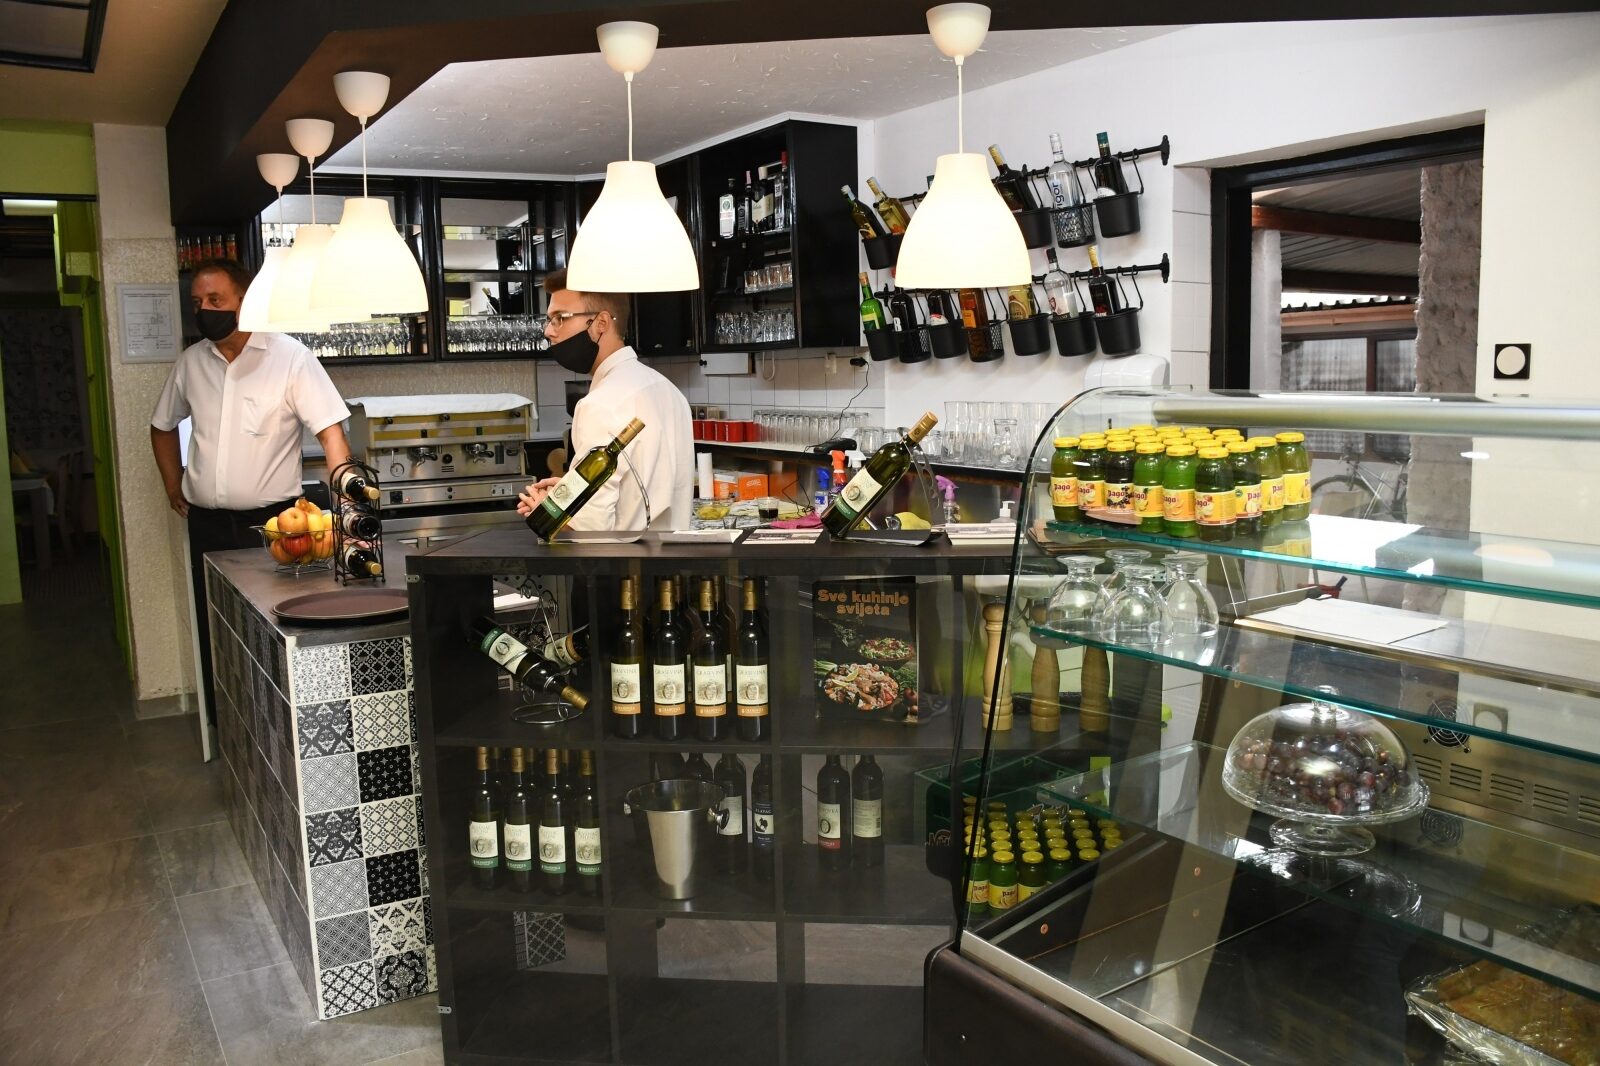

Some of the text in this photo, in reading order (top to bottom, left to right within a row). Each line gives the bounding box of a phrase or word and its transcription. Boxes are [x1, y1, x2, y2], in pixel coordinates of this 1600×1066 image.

[817, 589, 909, 607] Sve kuhinje
[836, 603, 890, 617] svijeta
